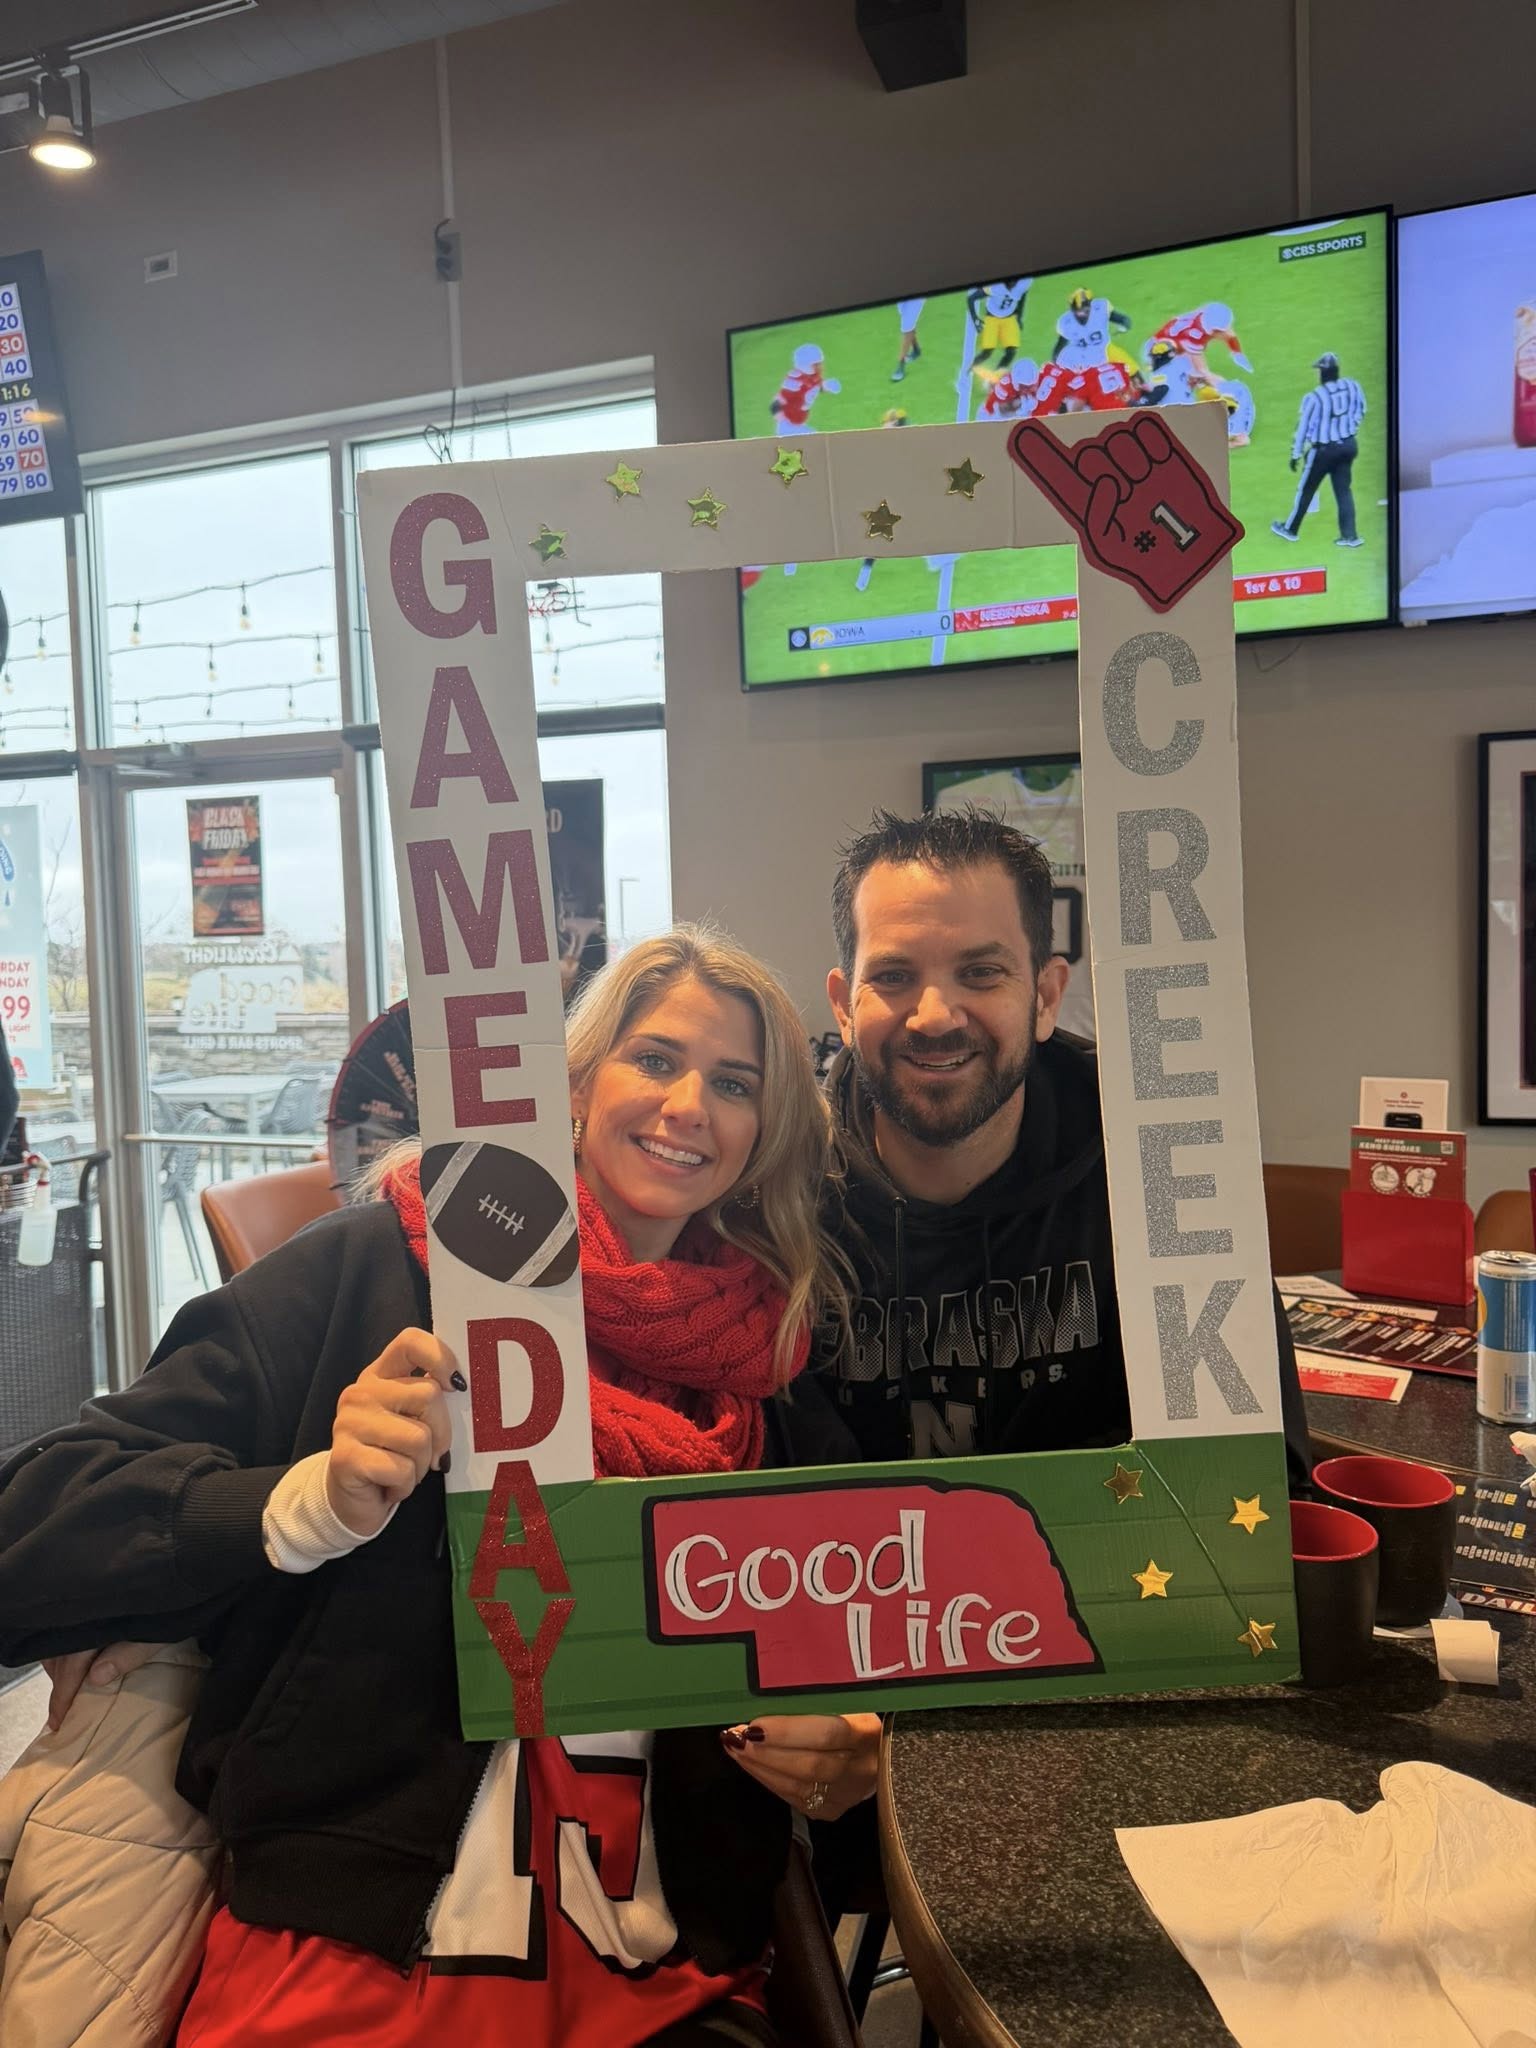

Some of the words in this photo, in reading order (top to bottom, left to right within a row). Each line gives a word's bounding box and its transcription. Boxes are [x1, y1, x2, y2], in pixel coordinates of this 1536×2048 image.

[1293, 245, 1316, 257] CBS
[1317, 235, 1363, 253] SPORTS
[0, 291, 13, 307] 0
[0, 314, 18, 331] 20
[0, 336, 22, 354] 30
[4, 359, 28, 376] 40
[1, 383, 31, 401] 1:16
[0, 411, 8, 427] 9
[18, 428, 39, 446] 60
[20, 451, 43, 468] 70
[25, 472, 48, 489] 80
[1133, 499, 1201, 554] #1
[1268, 578, 1281, 592] &
[1283, 576, 1301, 590] 10
[835, 626, 866, 640] IOWA
[940, 615, 951, 631] 0
[980, 602, 1051, 621] NEBRASKA
[389, 492, 550, 1129] GAME
[203, 827, 250, 850] FRIDAY
[0, 961, 31, 972] RDAY
[0, 977, 30, 988] NDAY
[1102, 631, 1264, 1421] CREEK
[813, 1261, 1099, 1382] EBRASKA
[838, 1364, 1069, 1406] USKERS.
[466, 1317, 577, 1737] DAY
[664, 1509, 926, 1621] Good
[1461, 1592, 1536, 1612] DAIL
[846, 1592, 1042, 1679] Life
